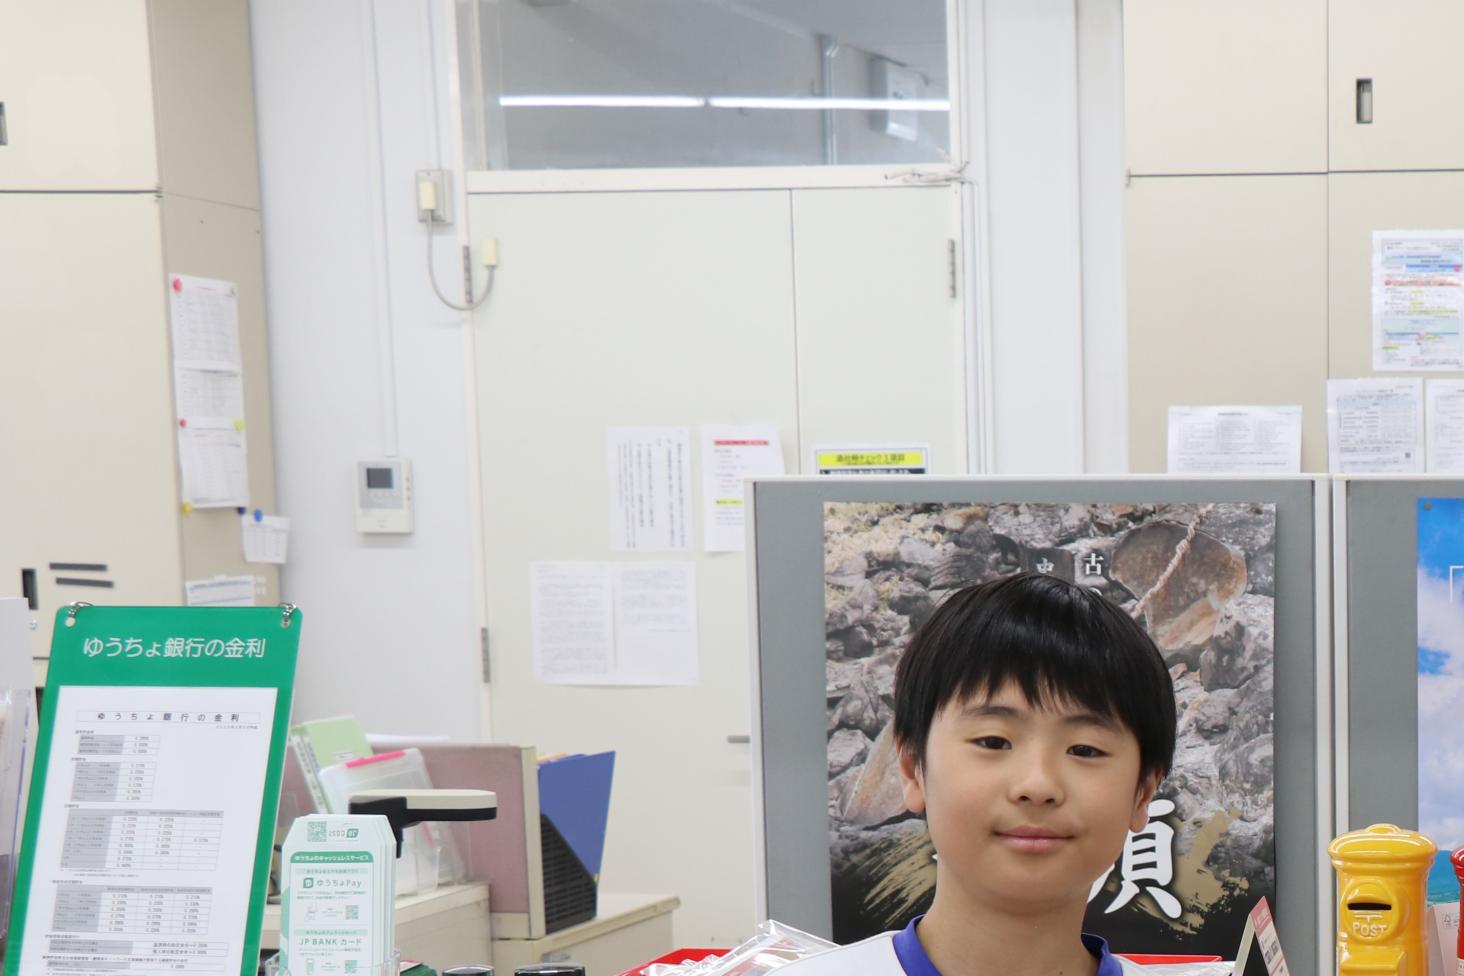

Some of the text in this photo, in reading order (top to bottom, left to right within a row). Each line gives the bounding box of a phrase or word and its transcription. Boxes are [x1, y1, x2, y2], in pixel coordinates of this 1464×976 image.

[83, 637, 265, 658] ゆうちょ銀行の金利
[98, 713, 239, 722] ゆうちょ銀行の金利
[317, 879, 362, 888] ゆうちょPay
[1352, 922, 1388, 937] POST
